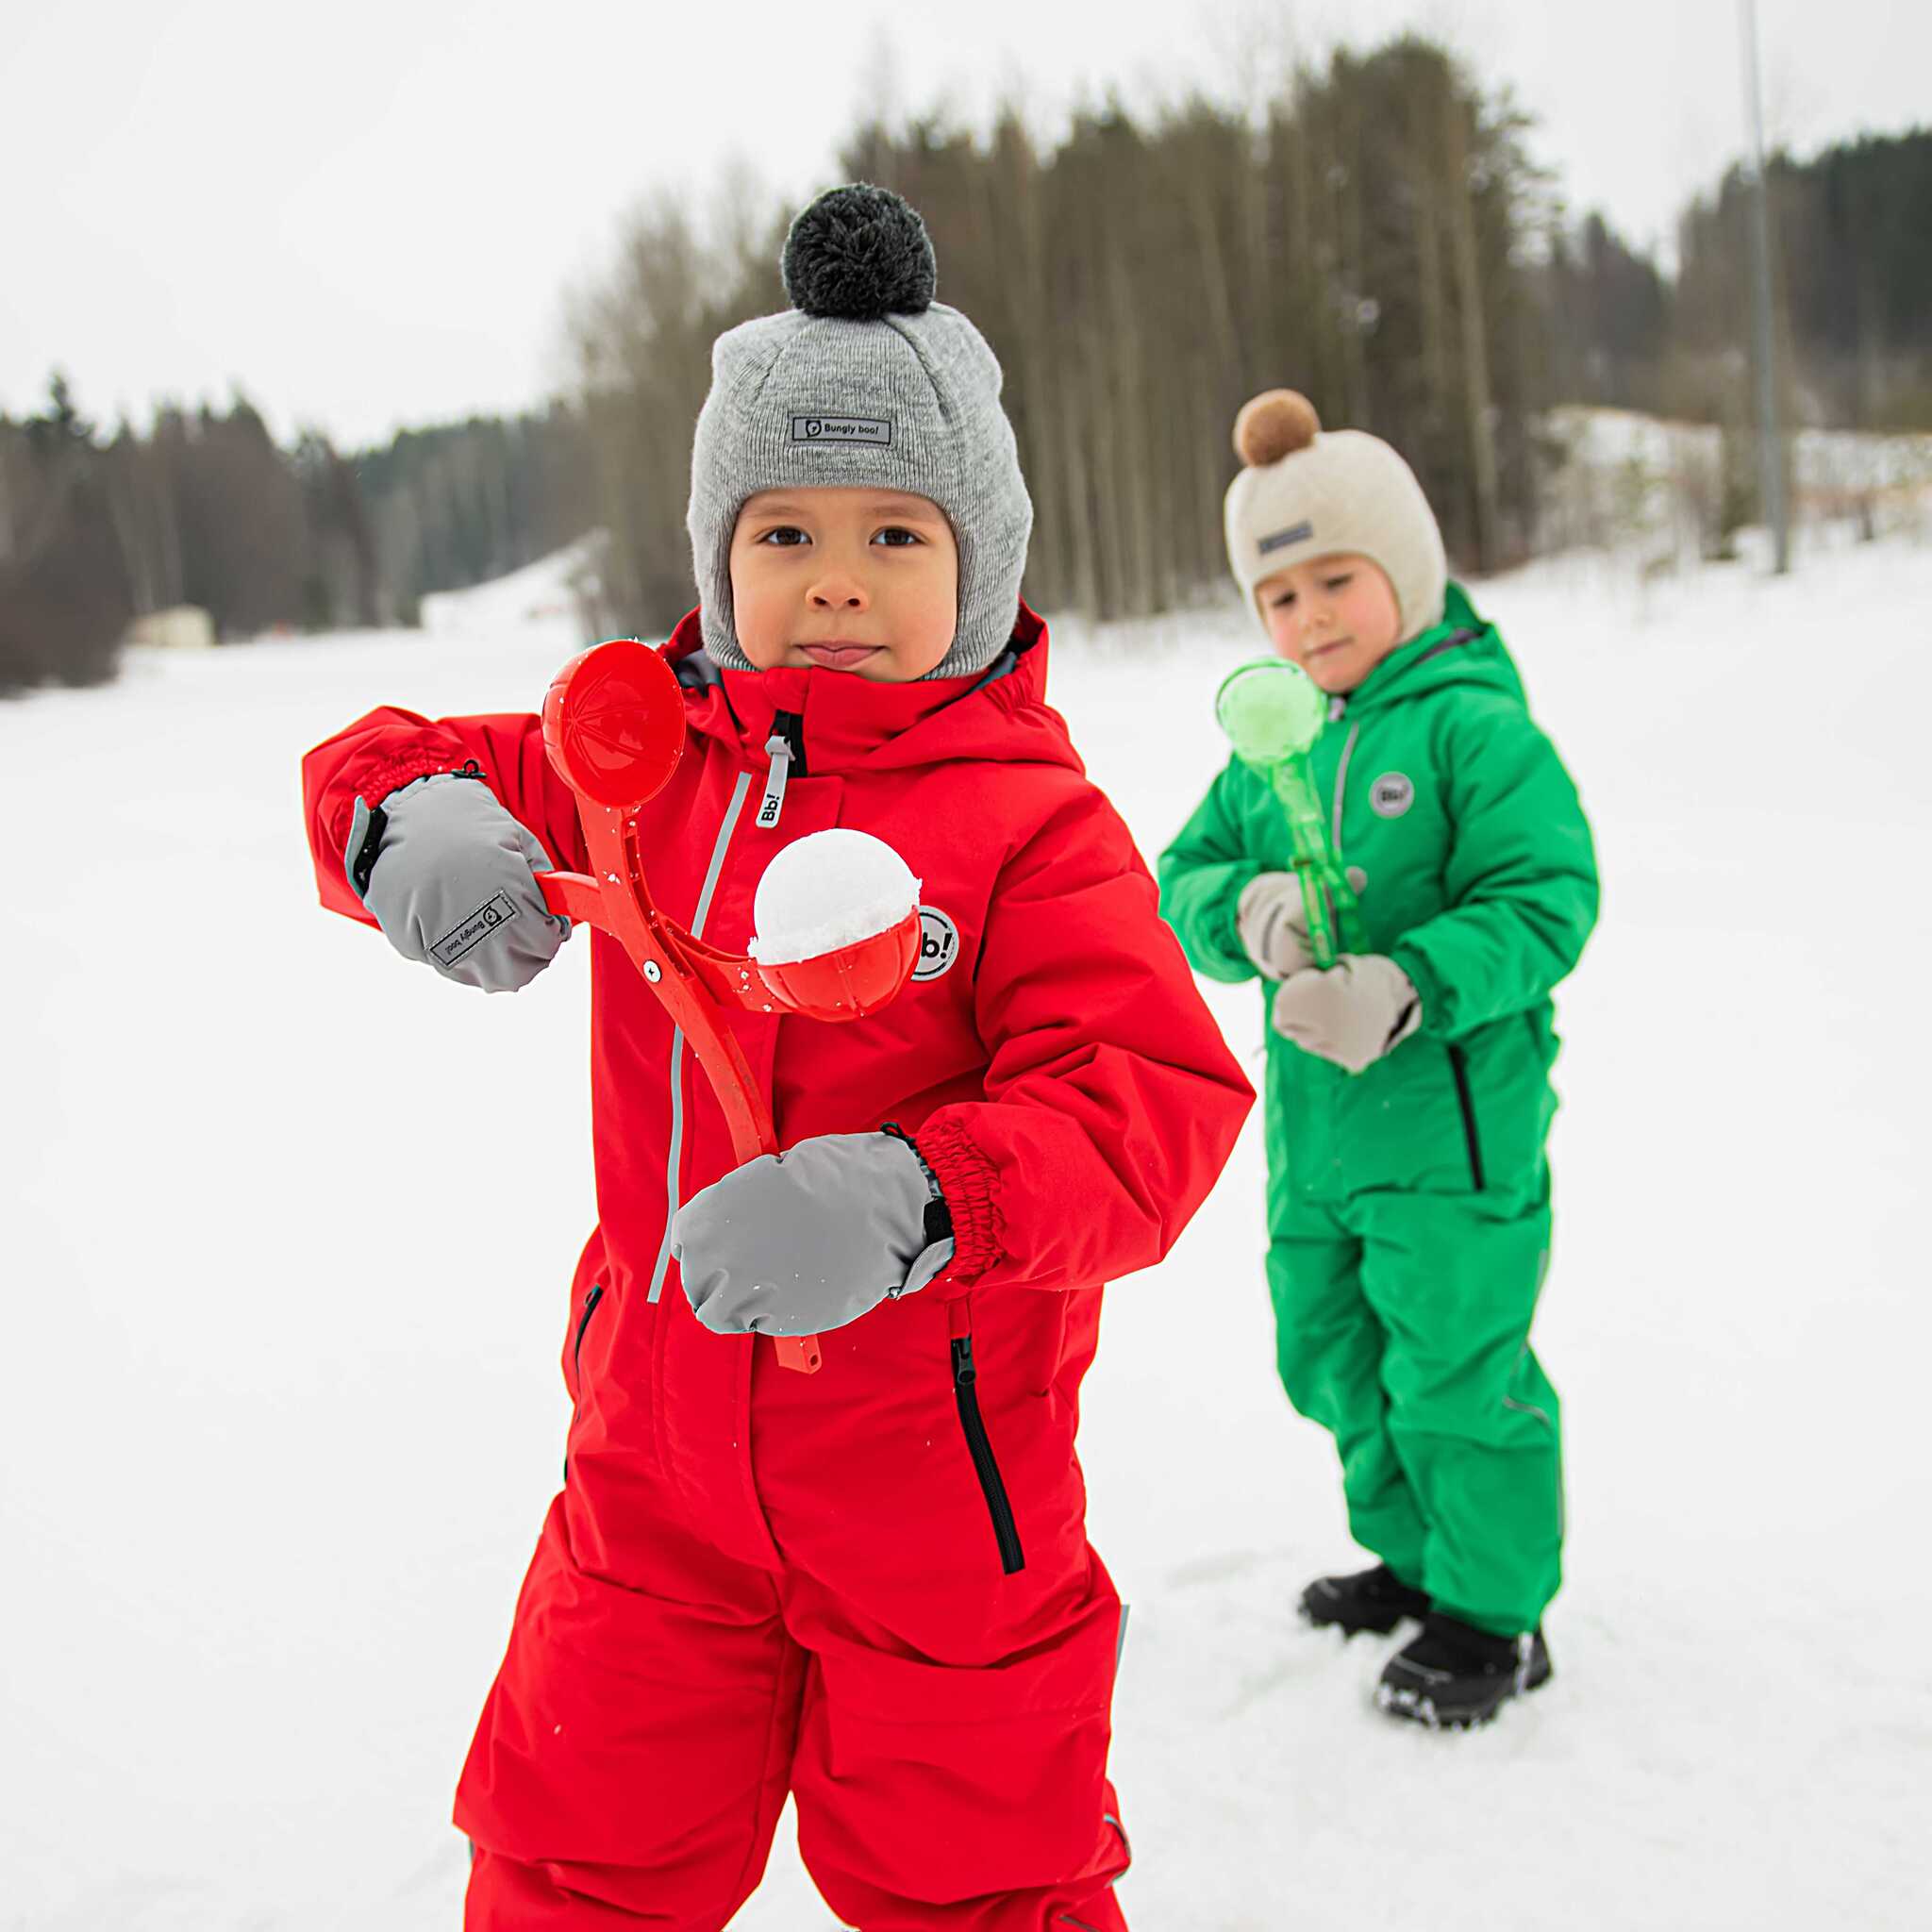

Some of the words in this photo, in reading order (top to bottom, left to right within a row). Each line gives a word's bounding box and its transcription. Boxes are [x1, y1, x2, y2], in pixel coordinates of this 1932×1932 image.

[824, 424, 856, 434] Bungly
[858, 425, 879, 435] boo!
[761, 793, 779, 821] Bb!
[459, 921, 486, 941] Bungly
[921, 932, 953, 958] b!
